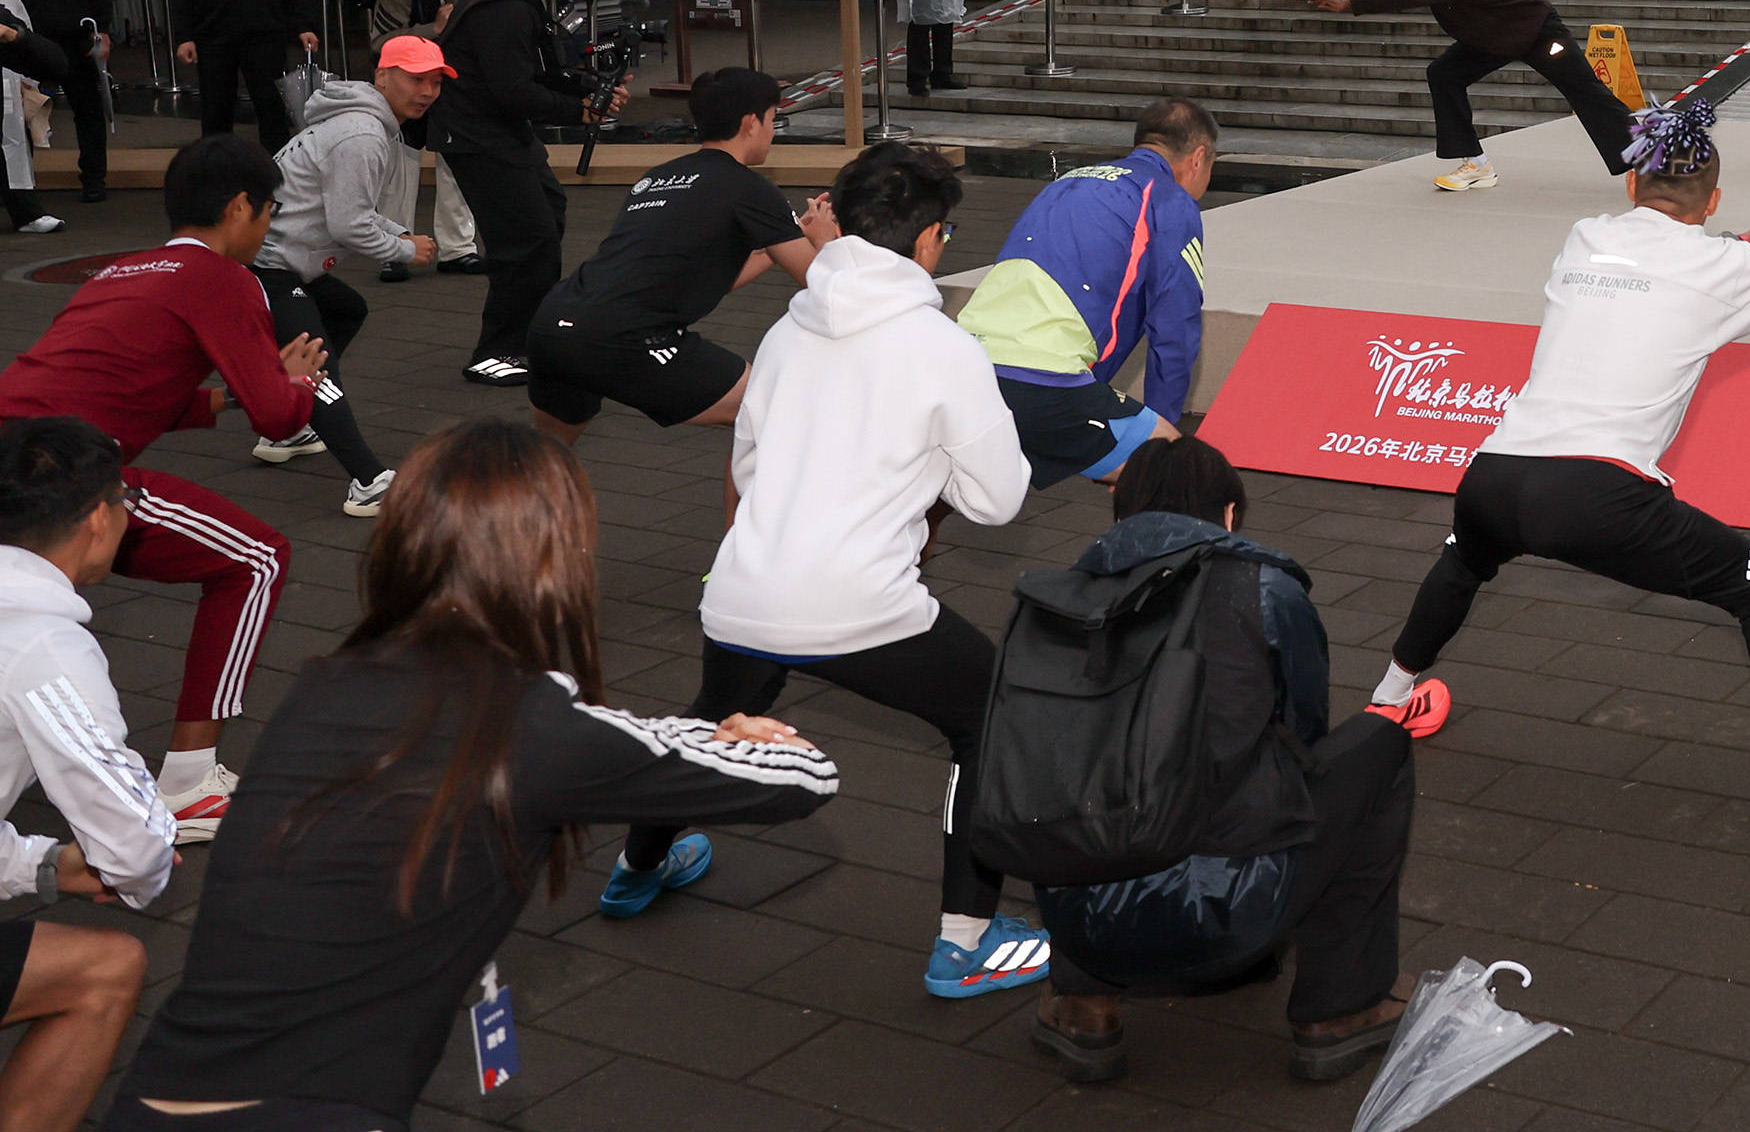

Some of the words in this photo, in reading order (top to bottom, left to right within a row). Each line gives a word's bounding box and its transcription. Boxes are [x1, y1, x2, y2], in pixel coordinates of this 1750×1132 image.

[627, 200, 667, 212] CAPTAIN
[1561, 271, 1597, 286] ADIDAS
[1597, 275, 1652, 293] RUNNERS
[1576, 285, 1618, 300] BEIJING
[1396, 406, 1443, 421] BEIJING
[1443, 410, 1503, 427] MARATHO
